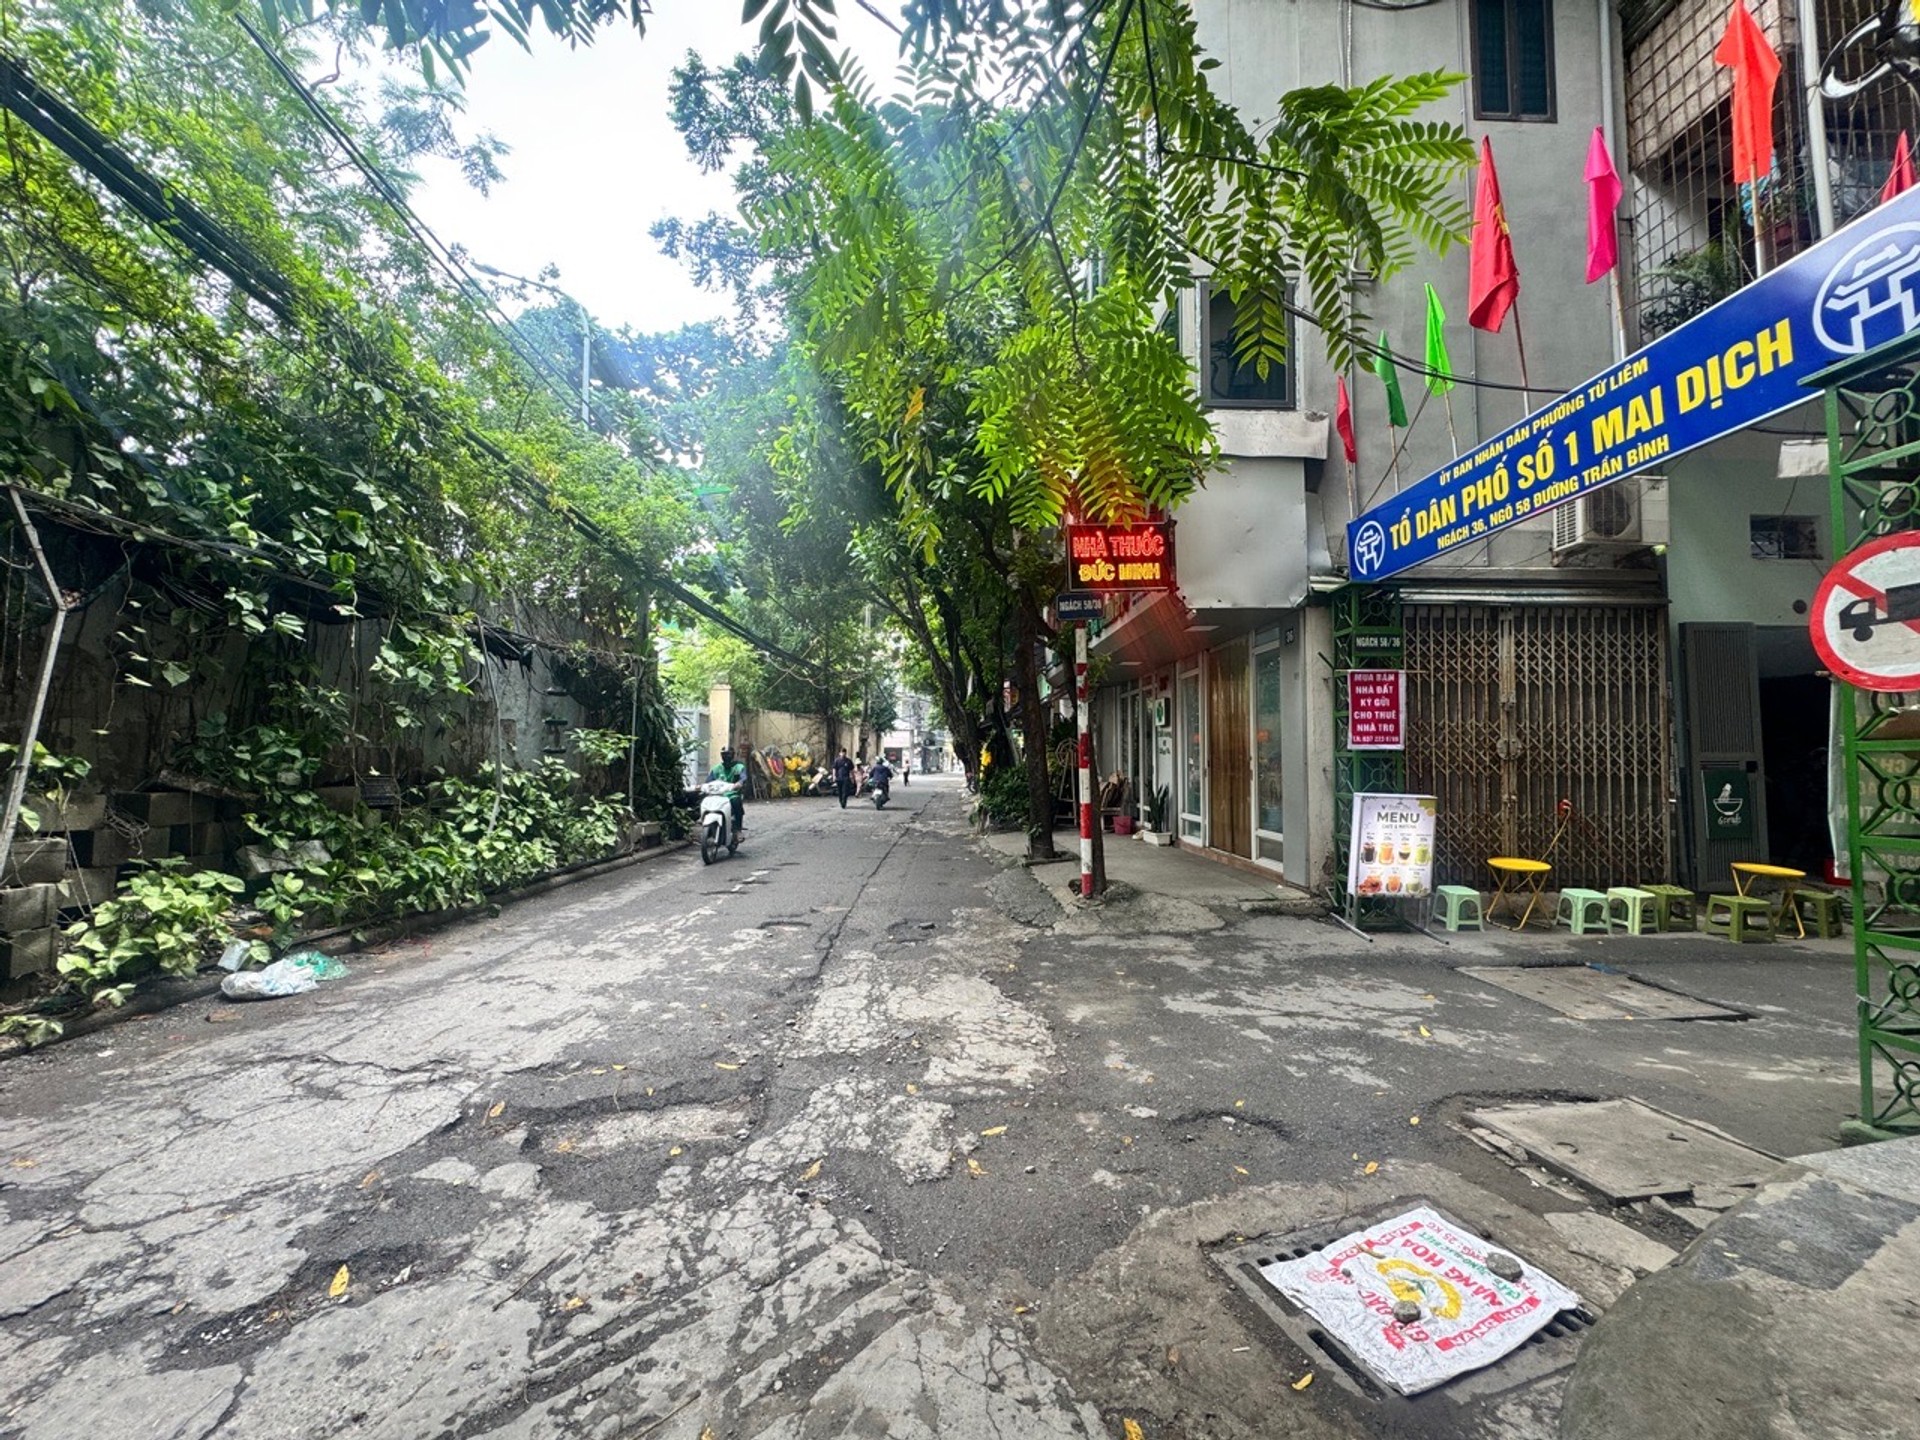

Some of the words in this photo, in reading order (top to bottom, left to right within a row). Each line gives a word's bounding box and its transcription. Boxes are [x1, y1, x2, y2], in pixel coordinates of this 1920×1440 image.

[1453, 458, 1473, 479] BAN
[1475, 440, 1504, 467] NHÂN
[1506, 425, 1529, 449] DÂN
[1533, 394, 1585, 434] PHƯỜNG
[1588, 378, 1607, 402] TỪ
[1610, 357, 1648, 391] LIÊM
[1390, 507, 1411, 550] TỔ
[1415, 495, 1457, 539] DÂN
[1462, 454, 1509, 517] PHỐ
[1517, 429, 1555, 489] SỐ
[1563, 430, 1579, 467] 1
[1592, 385, 1665, 455] MAI
[1676, 317, 1793, 415] DỊCH
[1437, 523, 1470, 550] NGÁCH
[1471, 519, 1488, 535] 36,
[1490, 502, 1513, 528] NGÕ
[1515, 498, 1531, 516] 58
[1533, 475, 1579, 509] ĐƯỜNG
[1582, 454, 1623, 486] TRẦN
[1626, 434, 1669, 468] BÌNH
[1072, 530, 1108, 558] NHÀ
[1109, 526, 1165, 557] THUỐC
[1078, 558, 1115, 581] ĐỨC
[1118, 562, 1160, 580] MINH
[1355, 684, 1374, 694] NHÀ
[1376, 683, 1394, 694] ĐẤT
[1354, 711, 1372, 720] CHO
[1374, 710, 1397, 720] THUÊ
[1357, 722, 1376, 732] NHÀ
[1378, 723, 1395, 733] TRỌ
[1377, 812, 1420, 823] MENU
[1401, 1239, 1445, 1267] HOA
